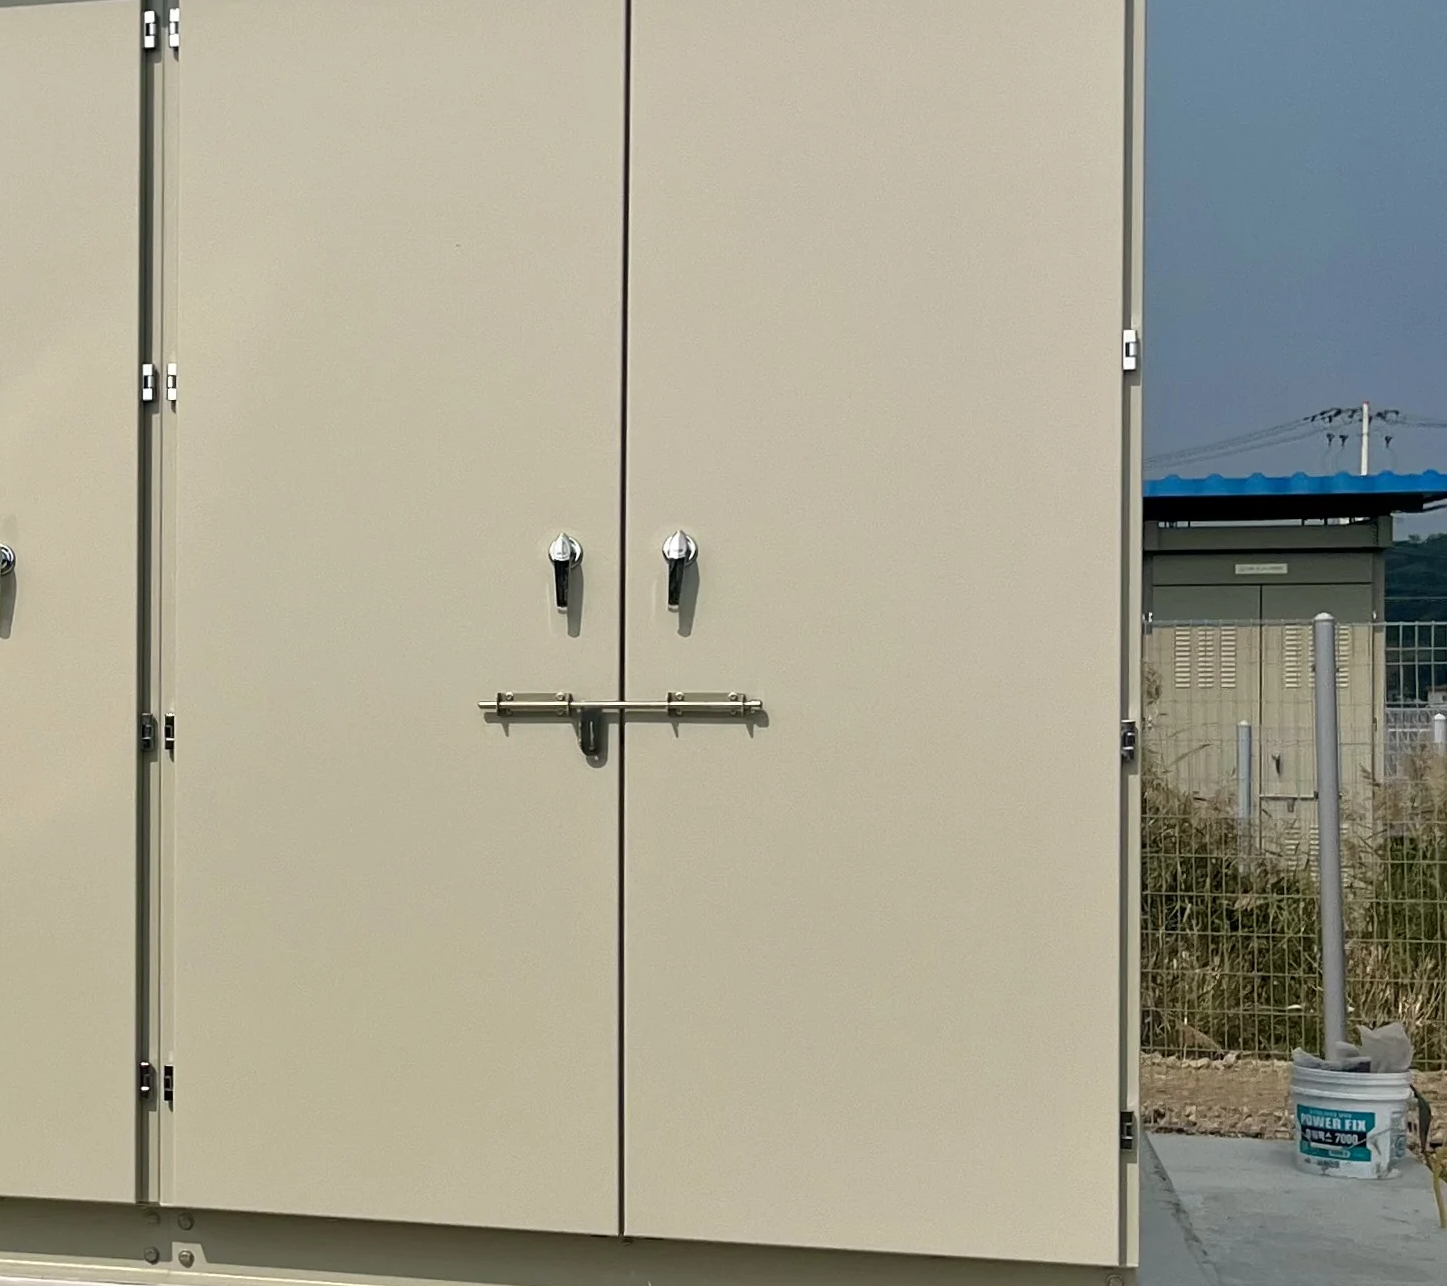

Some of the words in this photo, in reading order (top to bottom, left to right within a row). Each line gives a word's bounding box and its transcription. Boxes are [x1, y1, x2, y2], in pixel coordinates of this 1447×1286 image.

[1301, 1113, 1341, 1130] POWER
[1345, 1119, 1366, 1131] FIX
[1334, 1132, 1359, 1145] 7000
